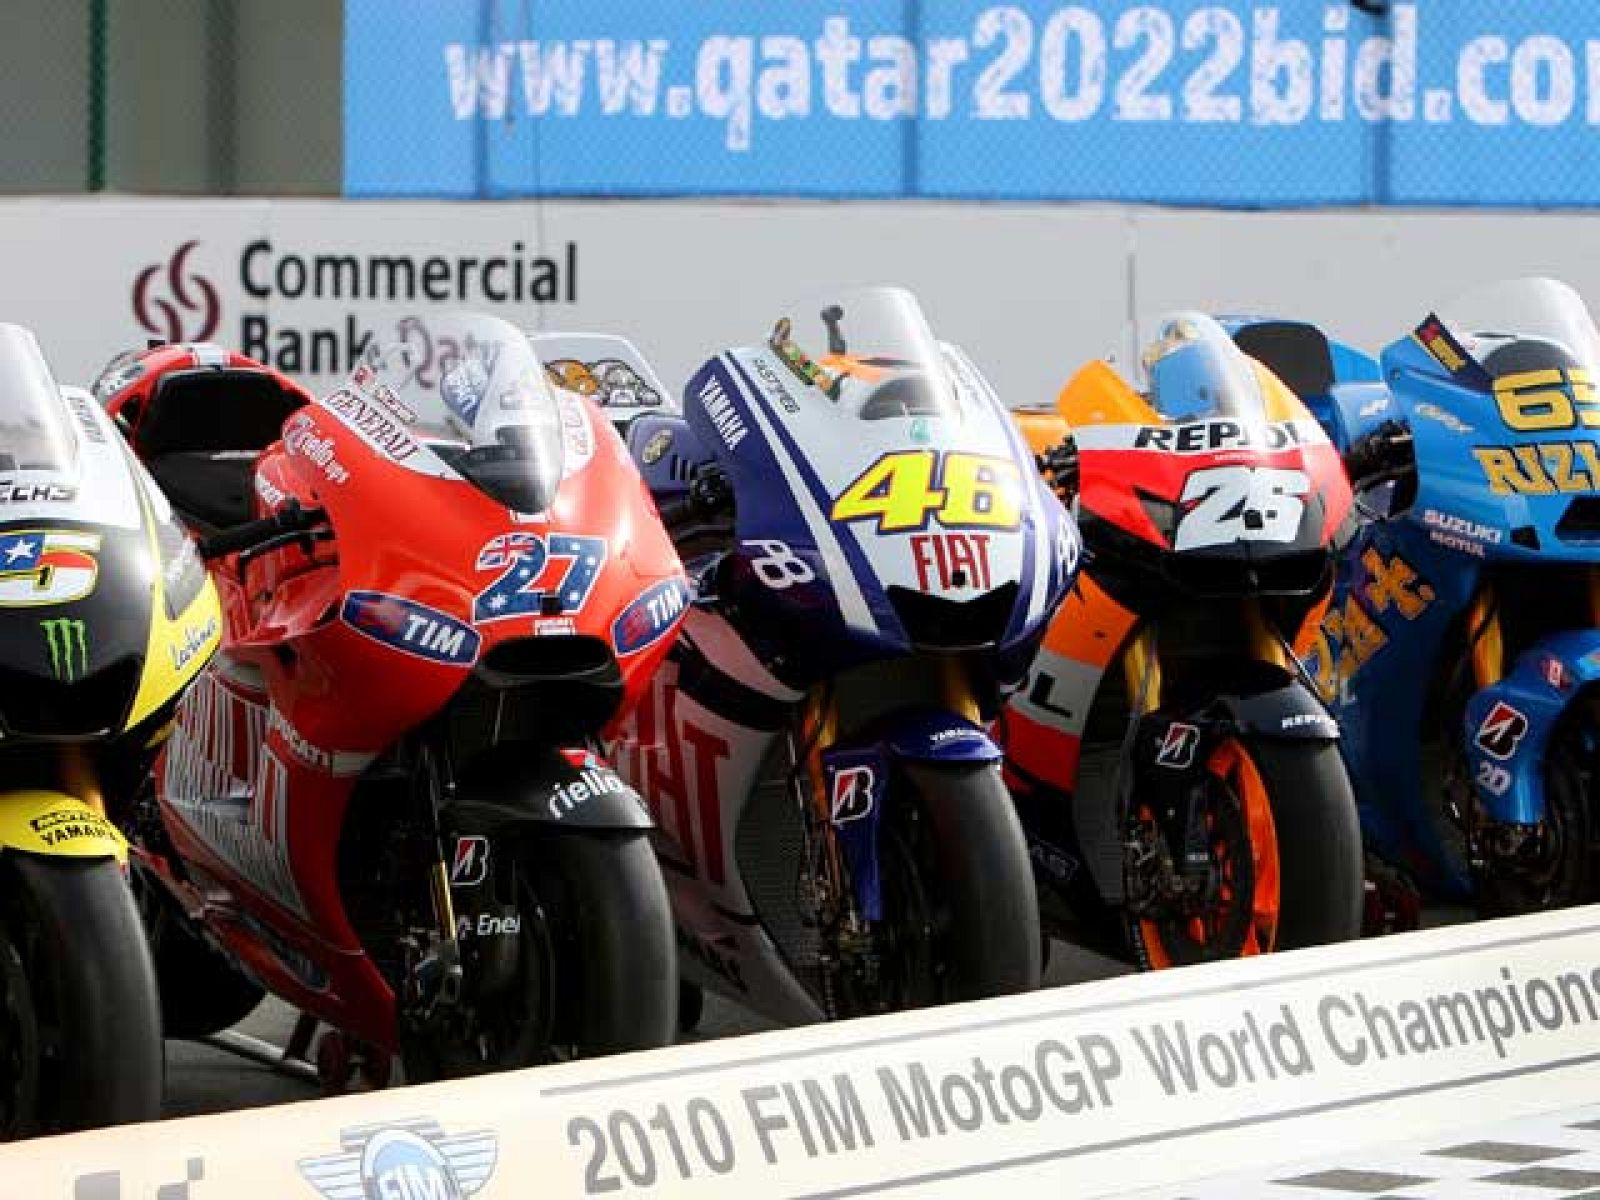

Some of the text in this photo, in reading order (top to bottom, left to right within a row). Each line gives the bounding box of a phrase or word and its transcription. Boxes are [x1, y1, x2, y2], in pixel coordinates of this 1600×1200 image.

[239, 240, 578, 302] Commercial
[241, 315, 373, 376] Bank
[324, 389, 420, 461] GENERALI
[699, 374, 749, 451] YAMAHA
[829, 450, 1024, 534] 46
[1175, 464, 1313, 551] 26
[1424, 509, 1501, 544] SUZUKI
[473, 533, 607, 624] 27
[908, 534, 992, 592] FIAT
[403, 613, 467, 659] TIM
[649, 583, 686, 628] TIM
[550, 766, 625, 821] riello
[477, 914, 521, 936] Enel
[566, 1096, 736, 1196] 2010
[740, 1072, 876, 1165] FIM
[876, 1033, 1123, 1142] MotoGP
[1130, 1003, 1316, 1097] World
